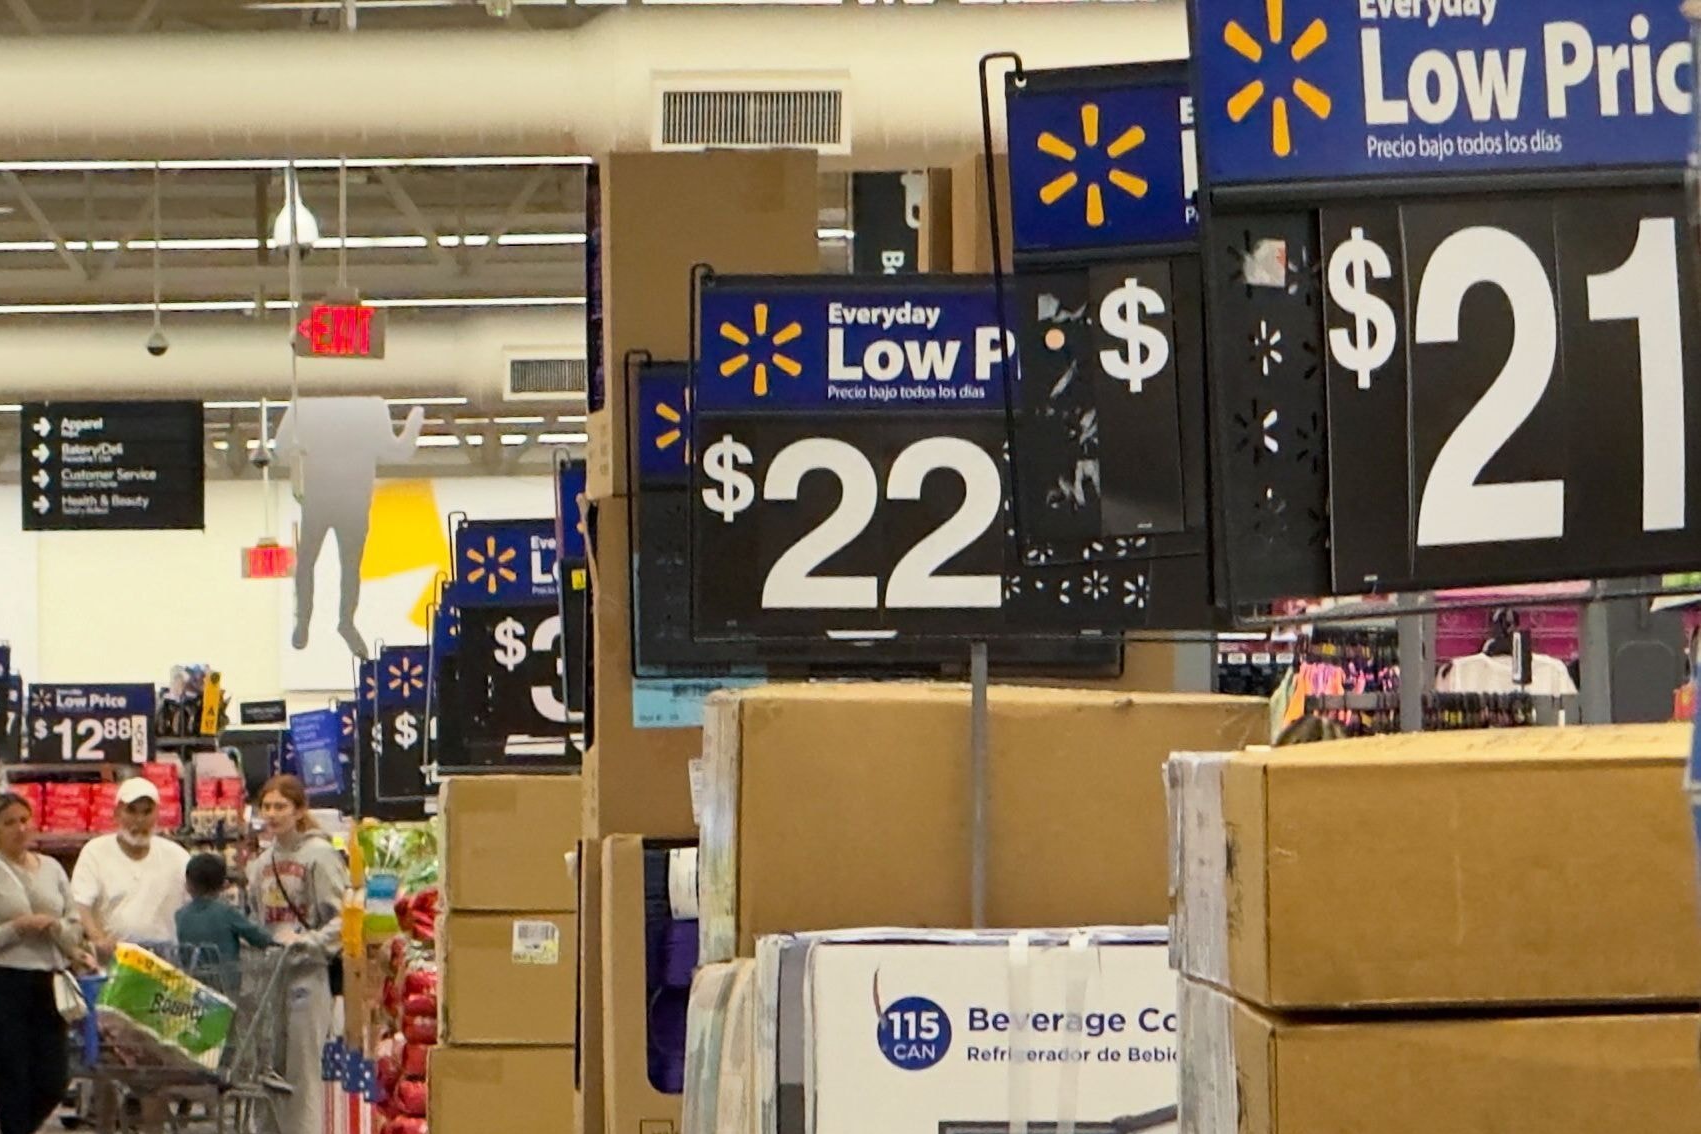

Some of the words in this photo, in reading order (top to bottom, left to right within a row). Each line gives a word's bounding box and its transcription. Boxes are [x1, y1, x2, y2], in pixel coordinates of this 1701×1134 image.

[1360, 27, 1527, 125] Low
[1367, 135, 1416, 159] Precio
[1419, 133, 1454, 161] bajo
[1457, 131, 1503, 155] todos
[1505, 129, 1528, 153] los
[311, 305, 374, 354] EXIT
[828, 301, 941, 330] Everyday
[1100, 278, 1169, 392] $
[828, 327, 961, 381] Low
[975, 326, 1019, 381] P
[828, 385, 866, 399] Precio
[870, 385, 898, 401] bajo
[901, 385, 936, 399] todos
[939, 385, 957, 399] los
[61, 417, 103, 432] Apparel
[61, 468, 115, 481] Customer
[117, 467, 157, 481] Service
[62, 495, 97, 508] Health
[112, 495, 150, 511] Beauty
[56, 694, 87, 707] Low
[89, 692, 127, 708] Price
[887, 1011, 940, 1041] 115
[968, 1006, 1126, 1037] Beverage
[893, 1045, 936, 1061] CAN
[967, 1046, 1090, 1065] Refrierador
[1097, 1046, 1122, 1062] de
